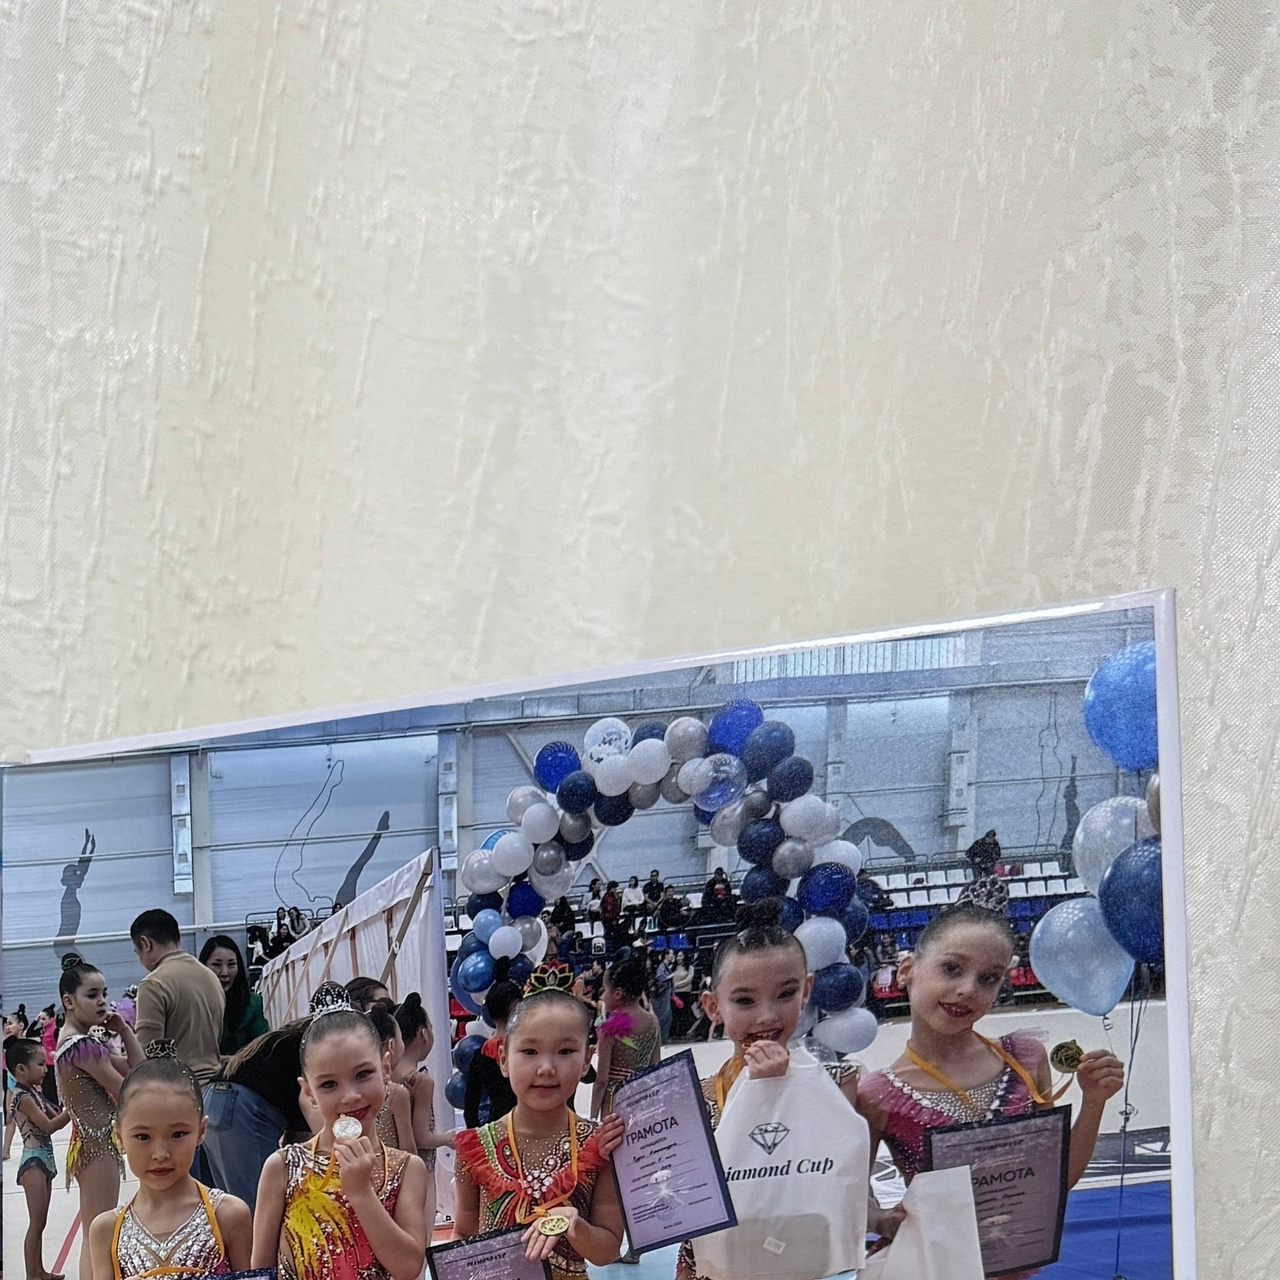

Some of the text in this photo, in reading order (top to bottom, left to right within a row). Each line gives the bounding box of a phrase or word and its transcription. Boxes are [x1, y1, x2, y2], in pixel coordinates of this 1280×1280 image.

[626, 1116, 679, 1146] ГРАМОТА
[723, 1157, 834, 1182] iamond Cup
[970, 1166, 1035, 1188] РАМОТА
